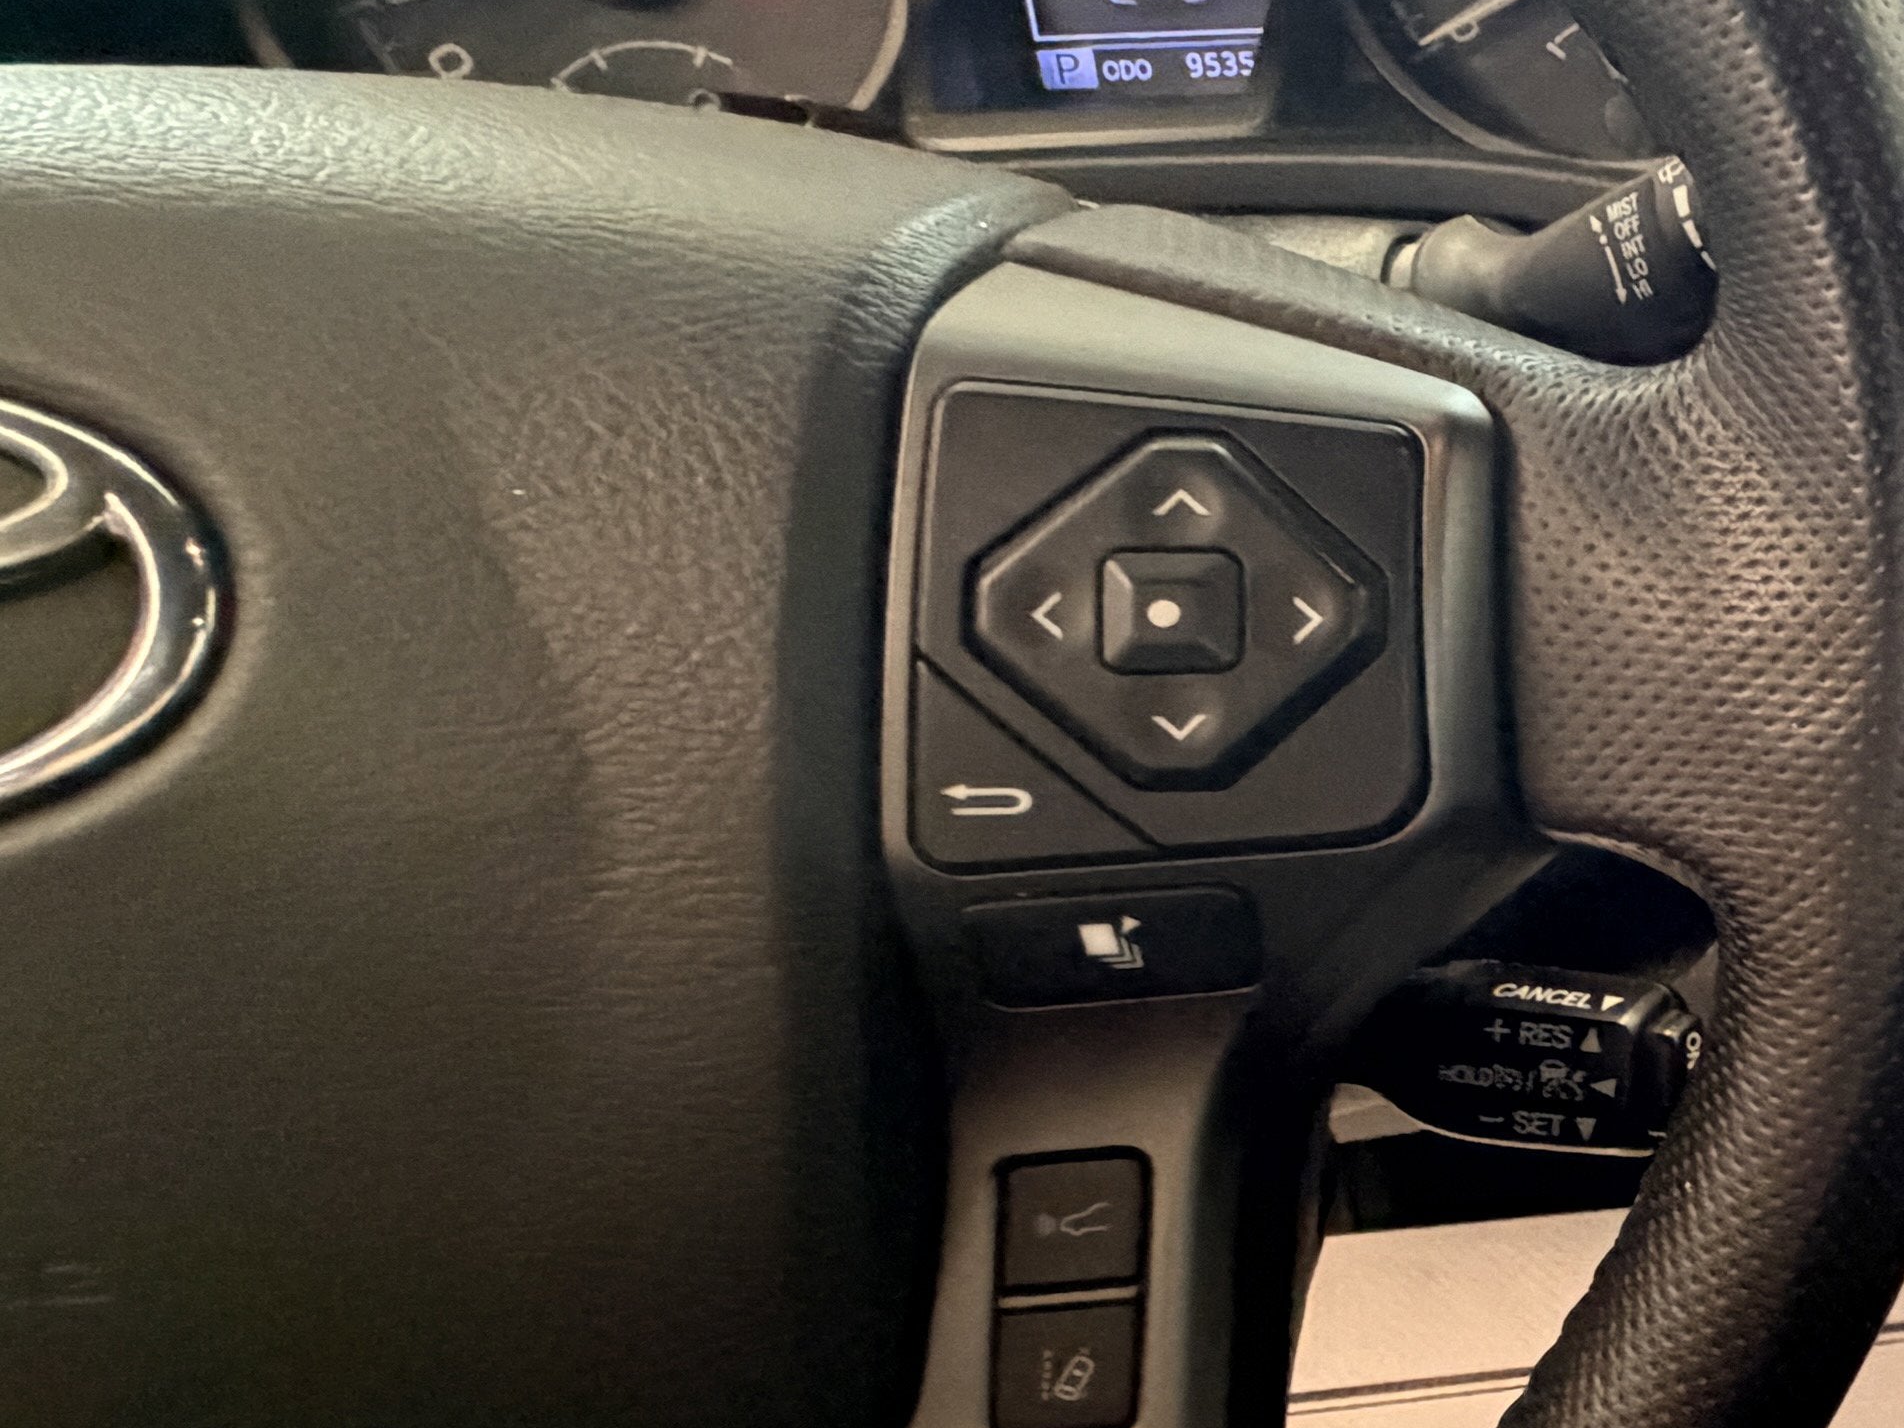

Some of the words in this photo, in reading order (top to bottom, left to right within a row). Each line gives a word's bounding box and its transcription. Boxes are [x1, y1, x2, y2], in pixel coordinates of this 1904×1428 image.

[1055, 53, 1080, 85] P
[1102, 58, 1153, 83] ODO
[1605, 191, 1638, 223] MIST
[1613, 213, 1641, 241] OFF
[1620, 233, 1647, 260] INT
[1625, 257, 1649, 280] LO
[1491, 981, 1593, 1011] CANCEL
[1518, 1020, 1574, 1050] RES
[1512, 1111, 1567, 1137] SET
